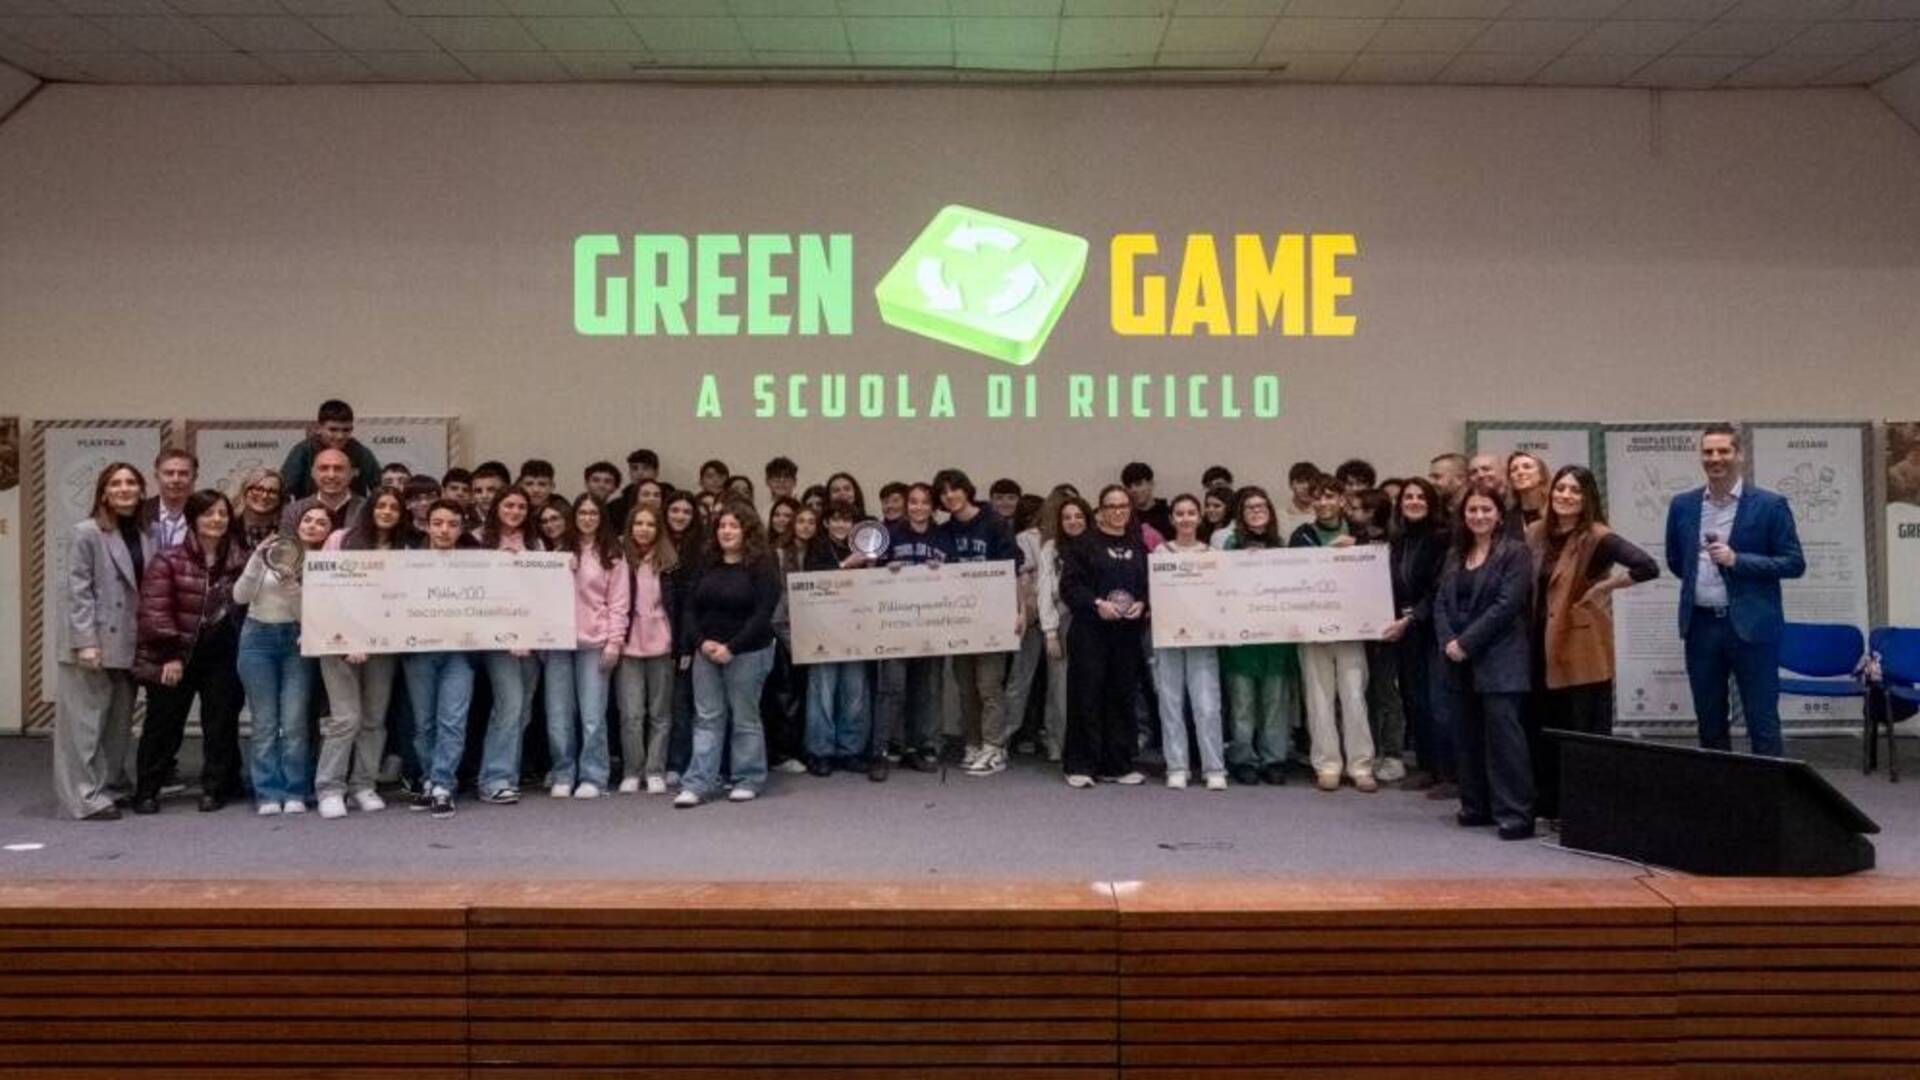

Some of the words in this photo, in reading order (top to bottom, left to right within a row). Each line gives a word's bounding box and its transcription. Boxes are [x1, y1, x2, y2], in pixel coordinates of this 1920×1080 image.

[574, 234, 853, 335] GREEN
[1110, 233, 1359, 335] GAME
[697, 375, 721, 418] A
[755, 375, 956, 418] SCUOLA
[987, 375, 1036, 418] DI
[1070, 375, 1282, 418] RICICLO
[373, 435, 406, 444] CARTA
